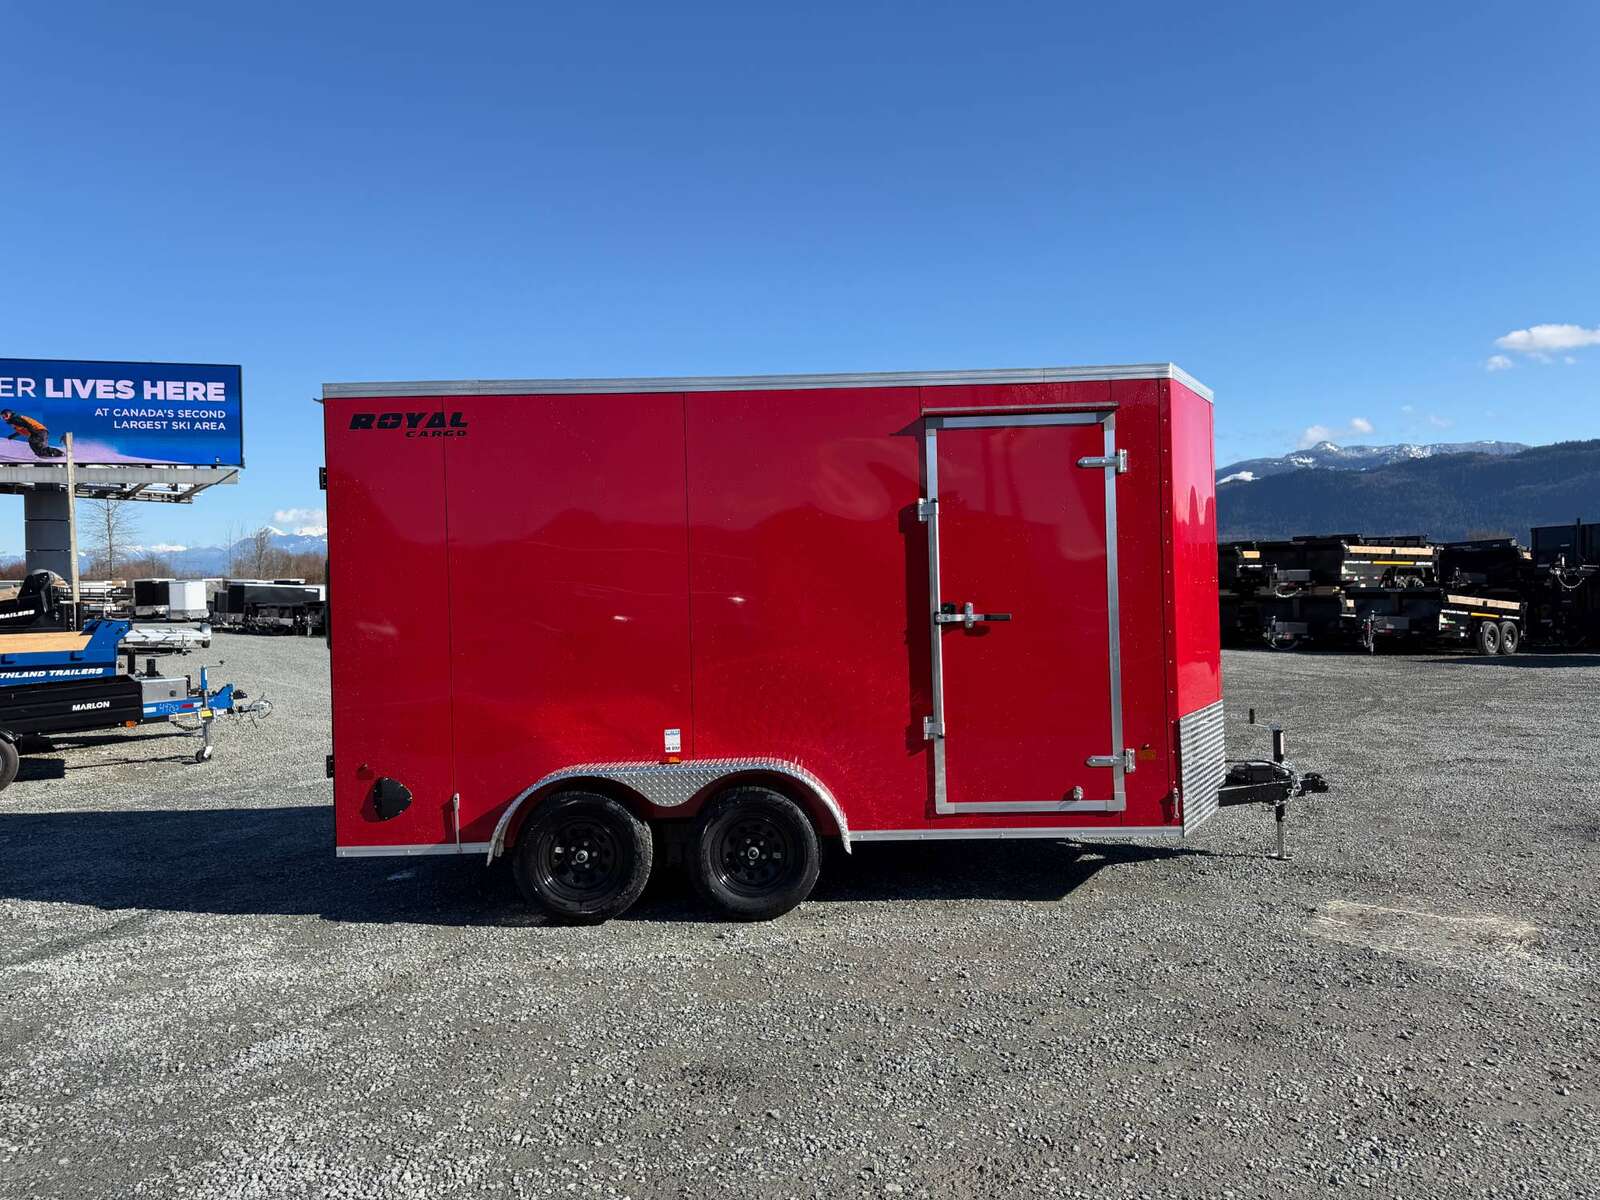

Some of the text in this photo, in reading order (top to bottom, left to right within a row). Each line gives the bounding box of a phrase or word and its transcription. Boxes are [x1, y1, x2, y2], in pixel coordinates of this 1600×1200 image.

[0, 377, 226, 402] ER LIVES HERE
[95, 408, 226, 419] AT CANADA'S SECOND
[114, 421, 226, 431] LARGEST SKI AREA
[349, 412, 468, 430] ROYAL
[405, 430, 468, 438] CARGO
[49, 667, 104, 677] TRAILERS
[72, 701, 110, 711] MARLON
